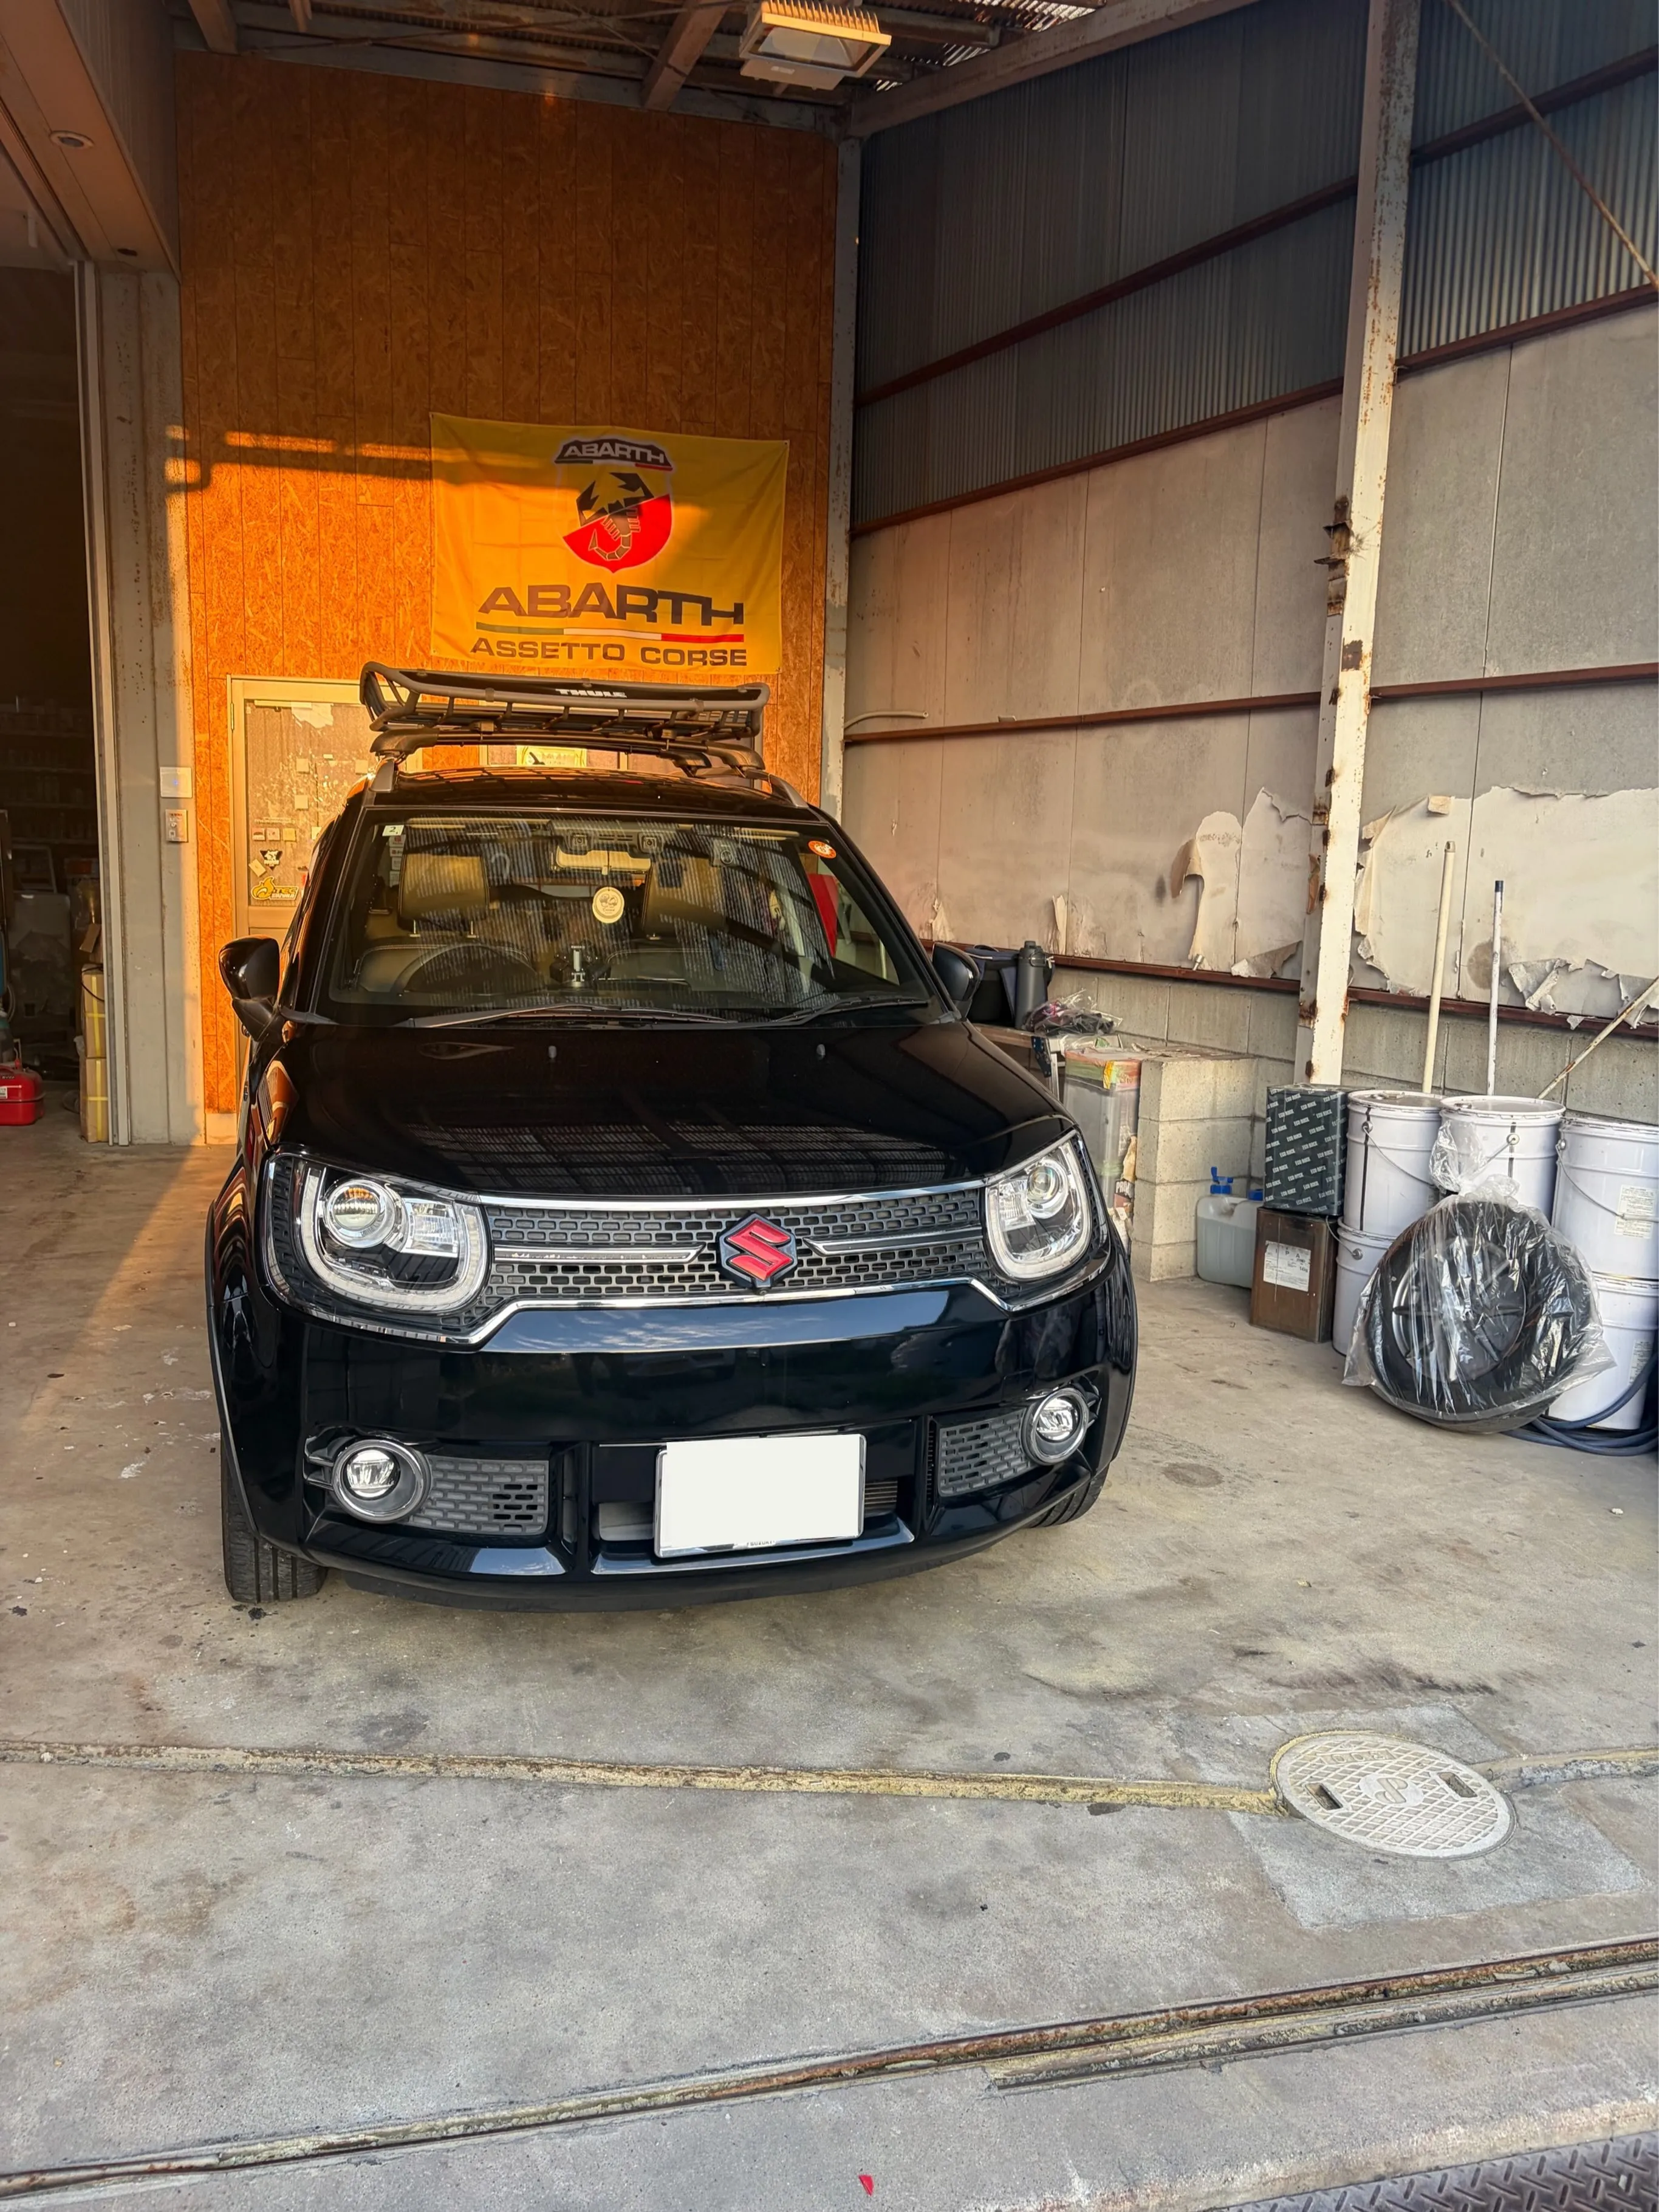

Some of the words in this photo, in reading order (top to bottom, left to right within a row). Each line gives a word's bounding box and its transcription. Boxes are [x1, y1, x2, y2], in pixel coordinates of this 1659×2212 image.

[564, 442, 665, 464] ABARTH
[477, 582, 744, 626] ABARTH
[470, 637, 625, 661] ASSETTO
[640, 646, 747, 666] CORSE
[555, 688, 628, 698] THULE
